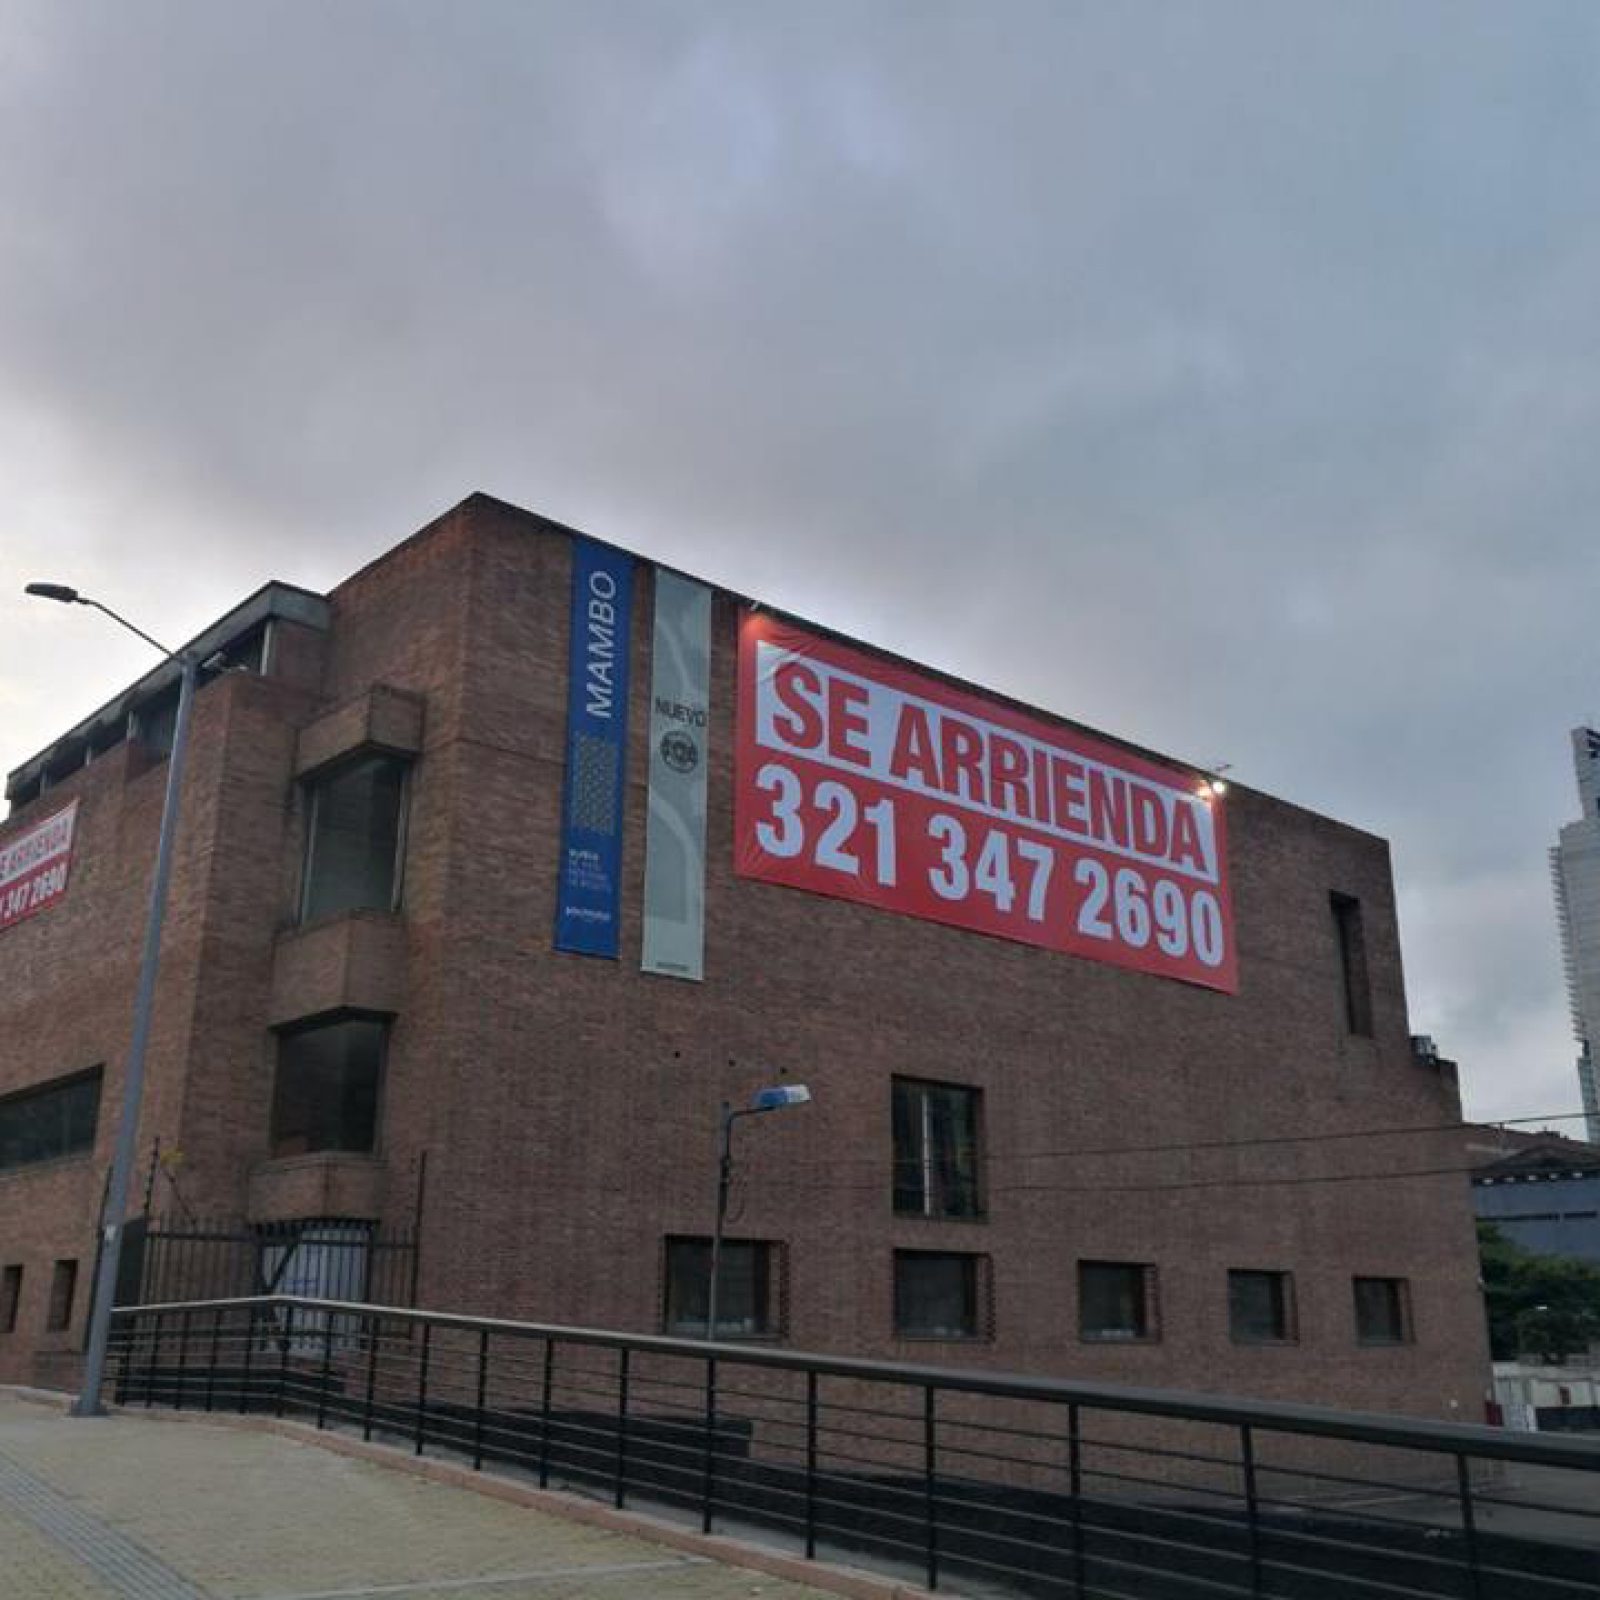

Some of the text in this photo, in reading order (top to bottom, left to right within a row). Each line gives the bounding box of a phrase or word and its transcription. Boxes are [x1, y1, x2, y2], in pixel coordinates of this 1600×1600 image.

[586, 570, 616, 718] MAMBO
[655, 695, 706, 728] NUEVO
[772, 661, 1207, 872] SE ARRIENDA
[754, 764, 1225, 967] 321 347 2690
